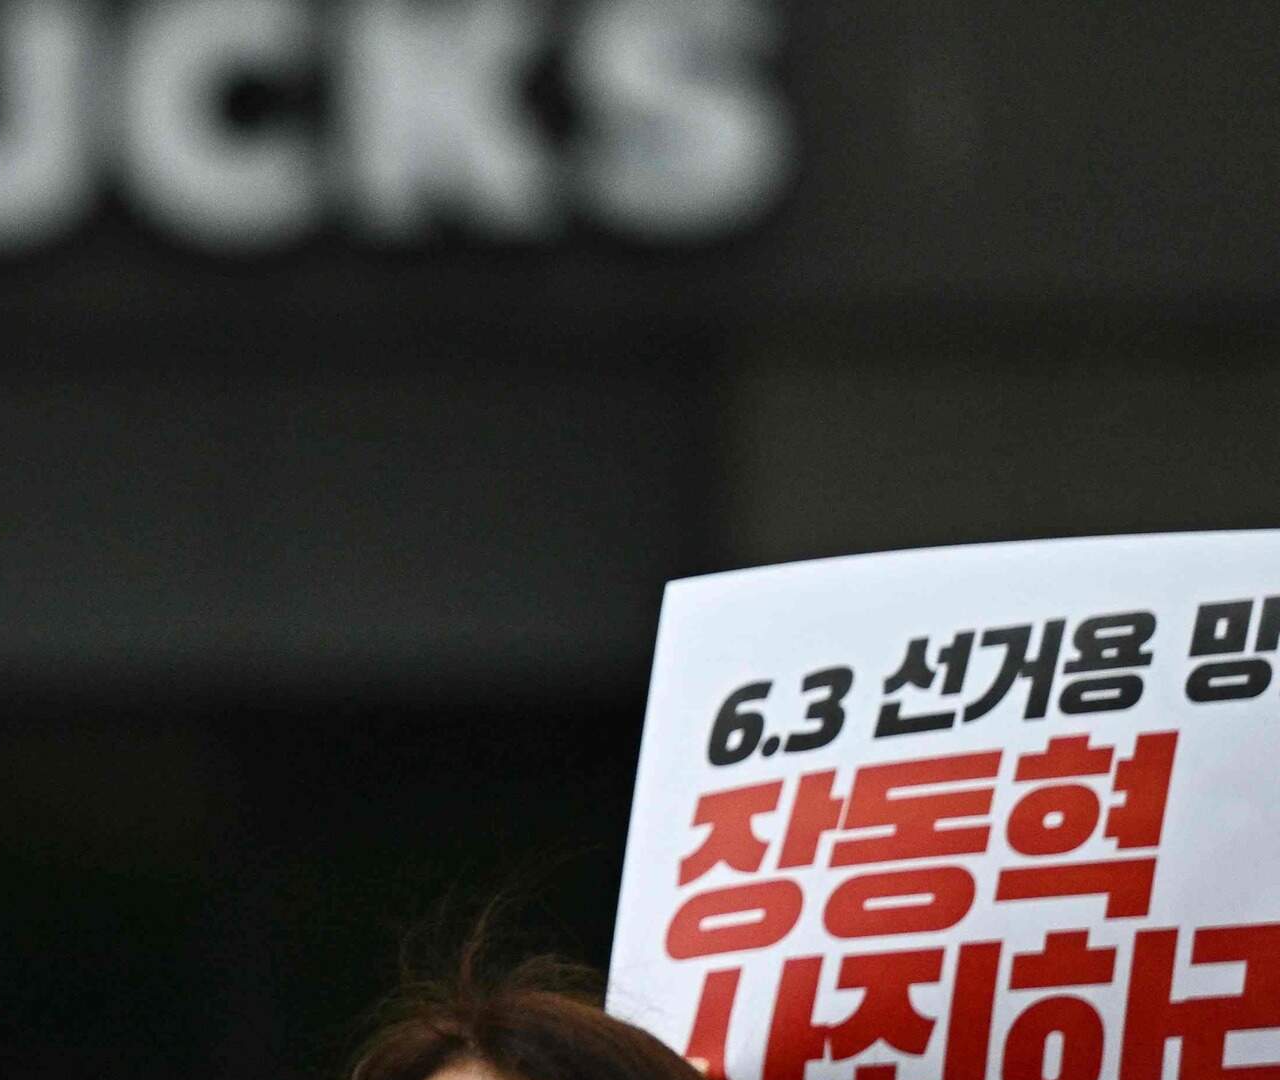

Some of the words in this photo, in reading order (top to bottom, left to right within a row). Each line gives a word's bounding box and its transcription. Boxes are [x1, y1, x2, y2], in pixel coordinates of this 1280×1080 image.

[706, 666, 854, 767] 6.3
[873, 610, 1157, 738] 선거용
[665, 730, 1179, 962] 장동혁
